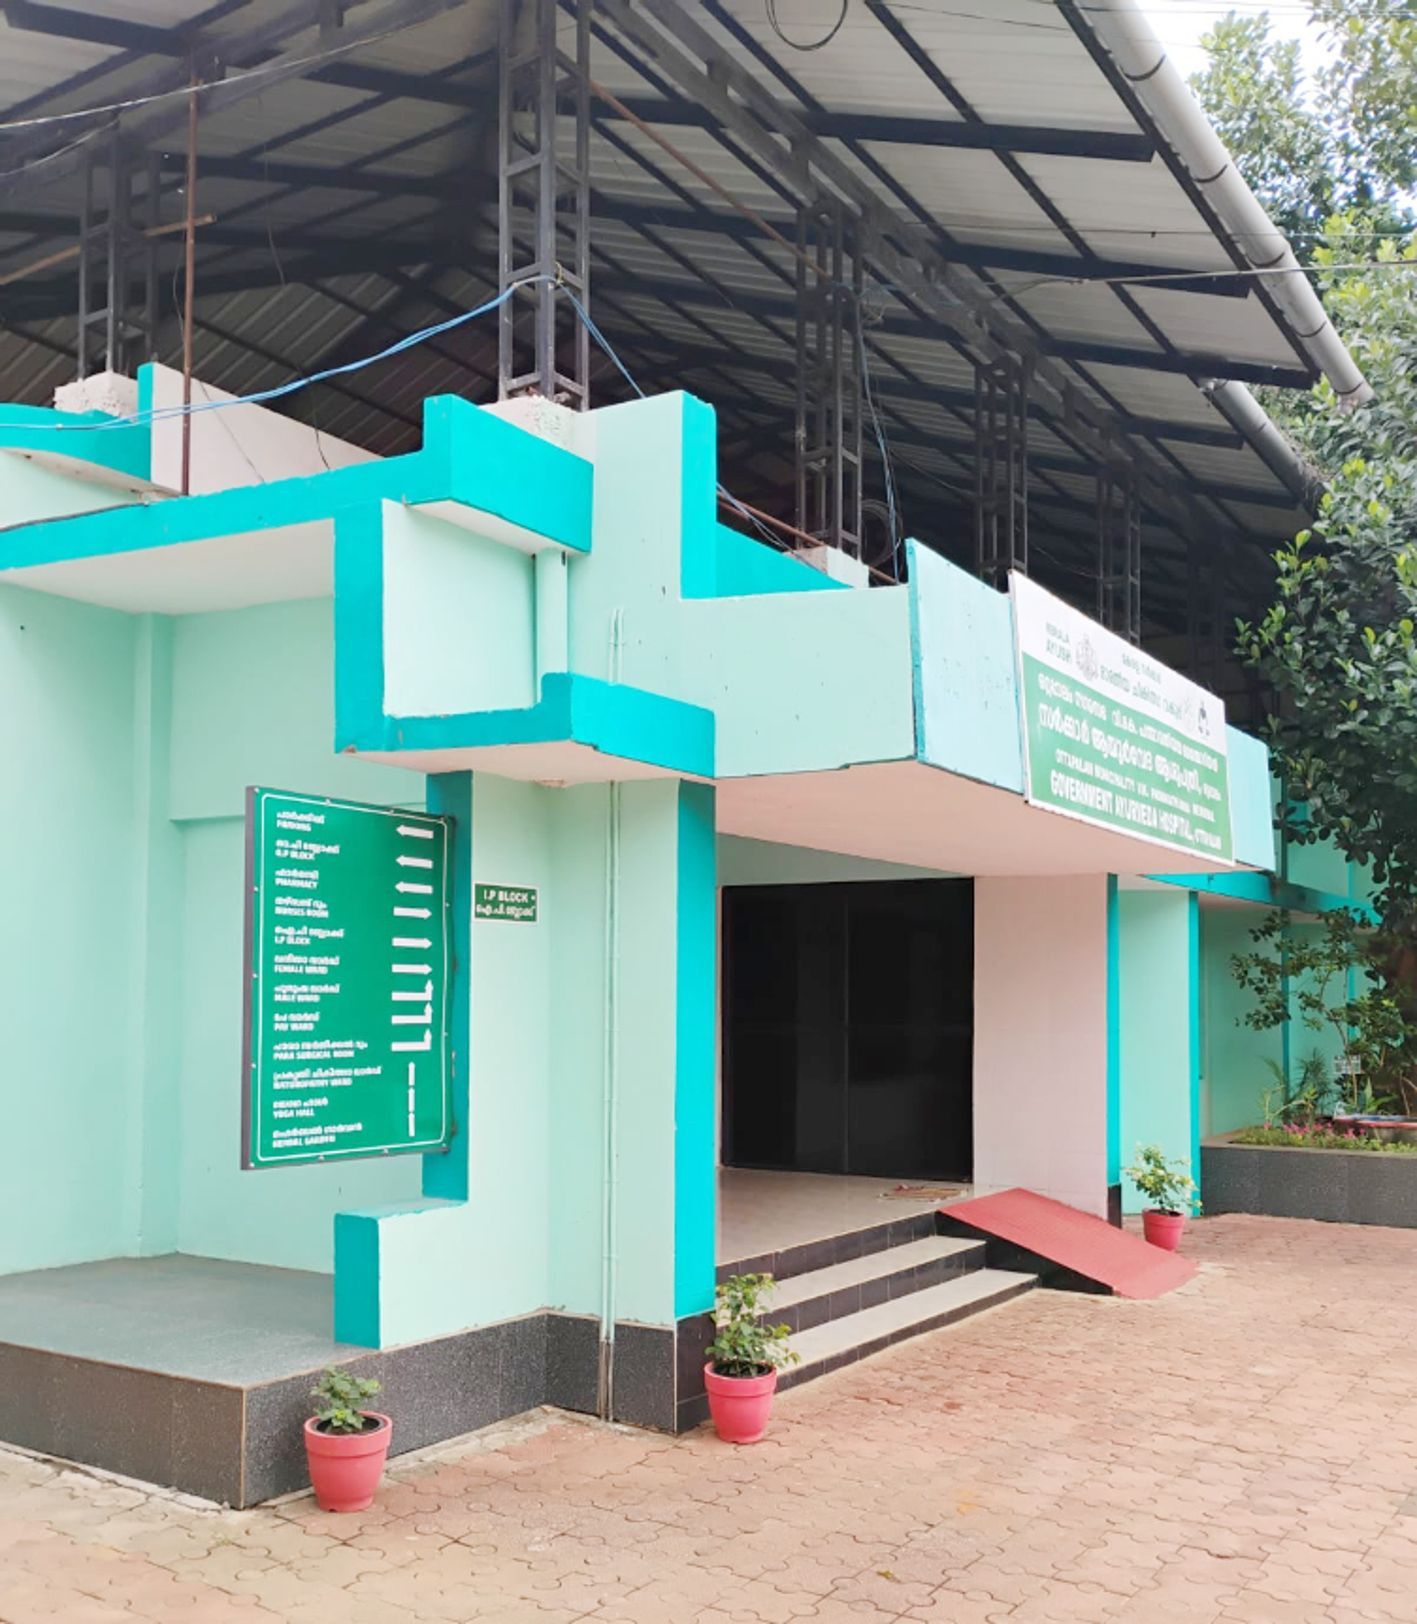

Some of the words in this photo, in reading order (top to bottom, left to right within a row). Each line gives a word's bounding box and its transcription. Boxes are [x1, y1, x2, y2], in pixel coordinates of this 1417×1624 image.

[1039, 703, 1090, 744] സർക്കാർ
[1052, 769, 1113, 814] GOVERNMENT
[1115, 794, 1158, 829] AYURVEDA
[277, 820, 312, 831] PARKING
[290, 851, 315, 860] BLOCK
[275, 878, 318, 889] PHARMACY
[498, 891, 529, 903] BLOCK
[307, 908, 329, 918] ROOM
[286, 936, 310, 945] BLOCK
[275, 964, 304, 973] FEMALE
[305, 966, 328, 975] WARD
[275, 993, 296, 1002] MALE
[297, 994, 320, 1002] WARD
[274, 1022, 288, 1031] PAY
[290, 1023, 315, 1031] WARD
[274, 1051, 295, 1060] PARA
[296, 1050, 331, 1060] SURGICAL
[333, 1050, 355, 1058] ROOM
[330, 1077, 353, 1087] WARD
[273, 1109, 294, 1118] YOGA
[295, 1108, 315, 1117] HALL
